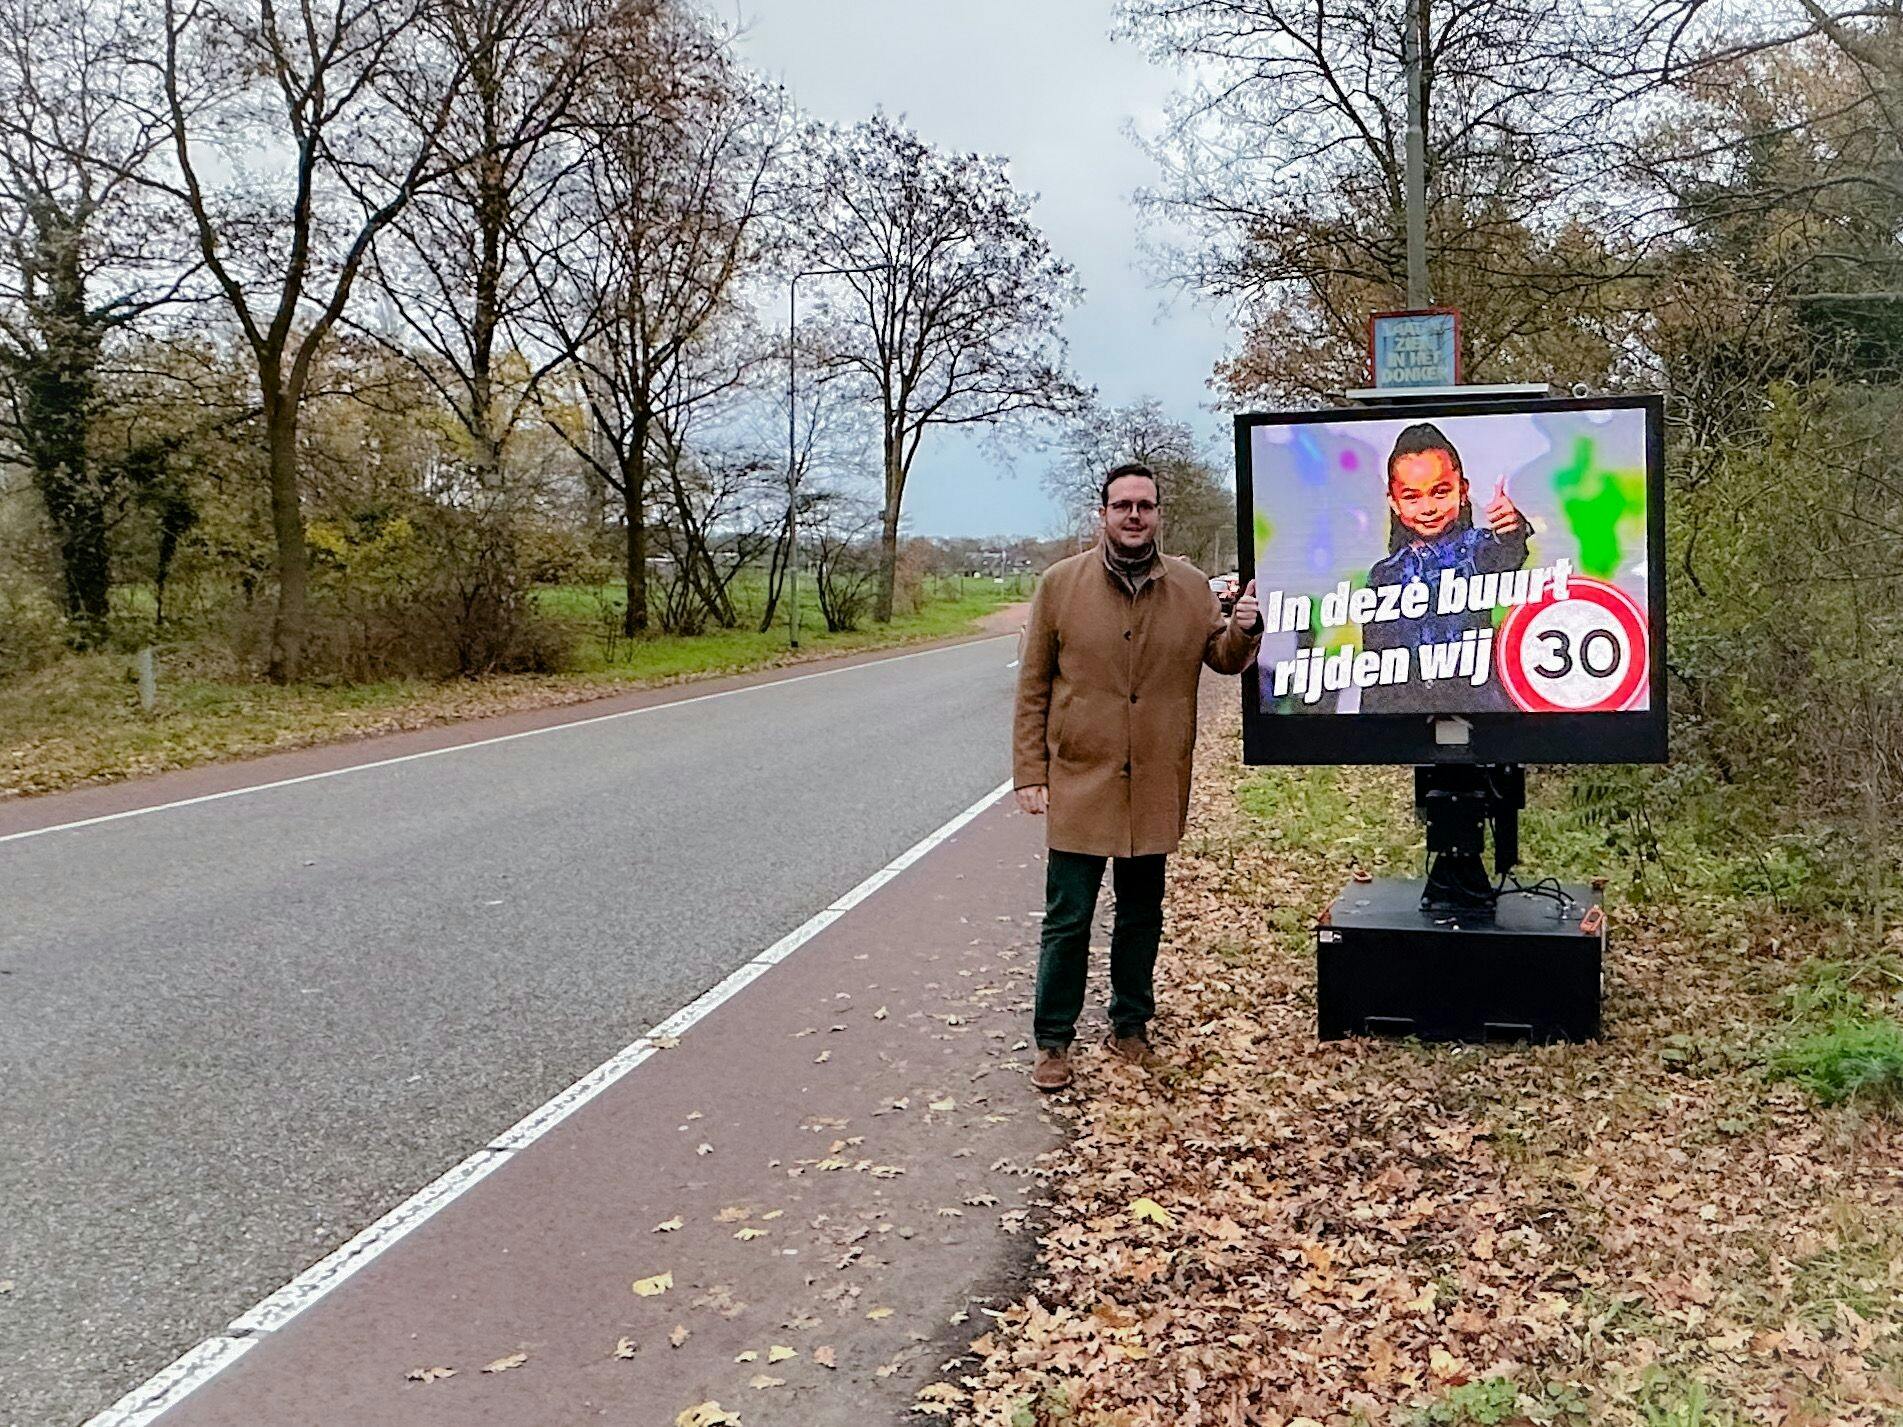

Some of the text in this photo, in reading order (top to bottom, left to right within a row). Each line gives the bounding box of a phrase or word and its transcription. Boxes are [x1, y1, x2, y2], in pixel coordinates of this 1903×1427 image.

[1266, 558, 1574, 634] In deze buurt
[1273, 628, 1494, 704] rijden wij
[1534, 629, 1621, 678] 30
